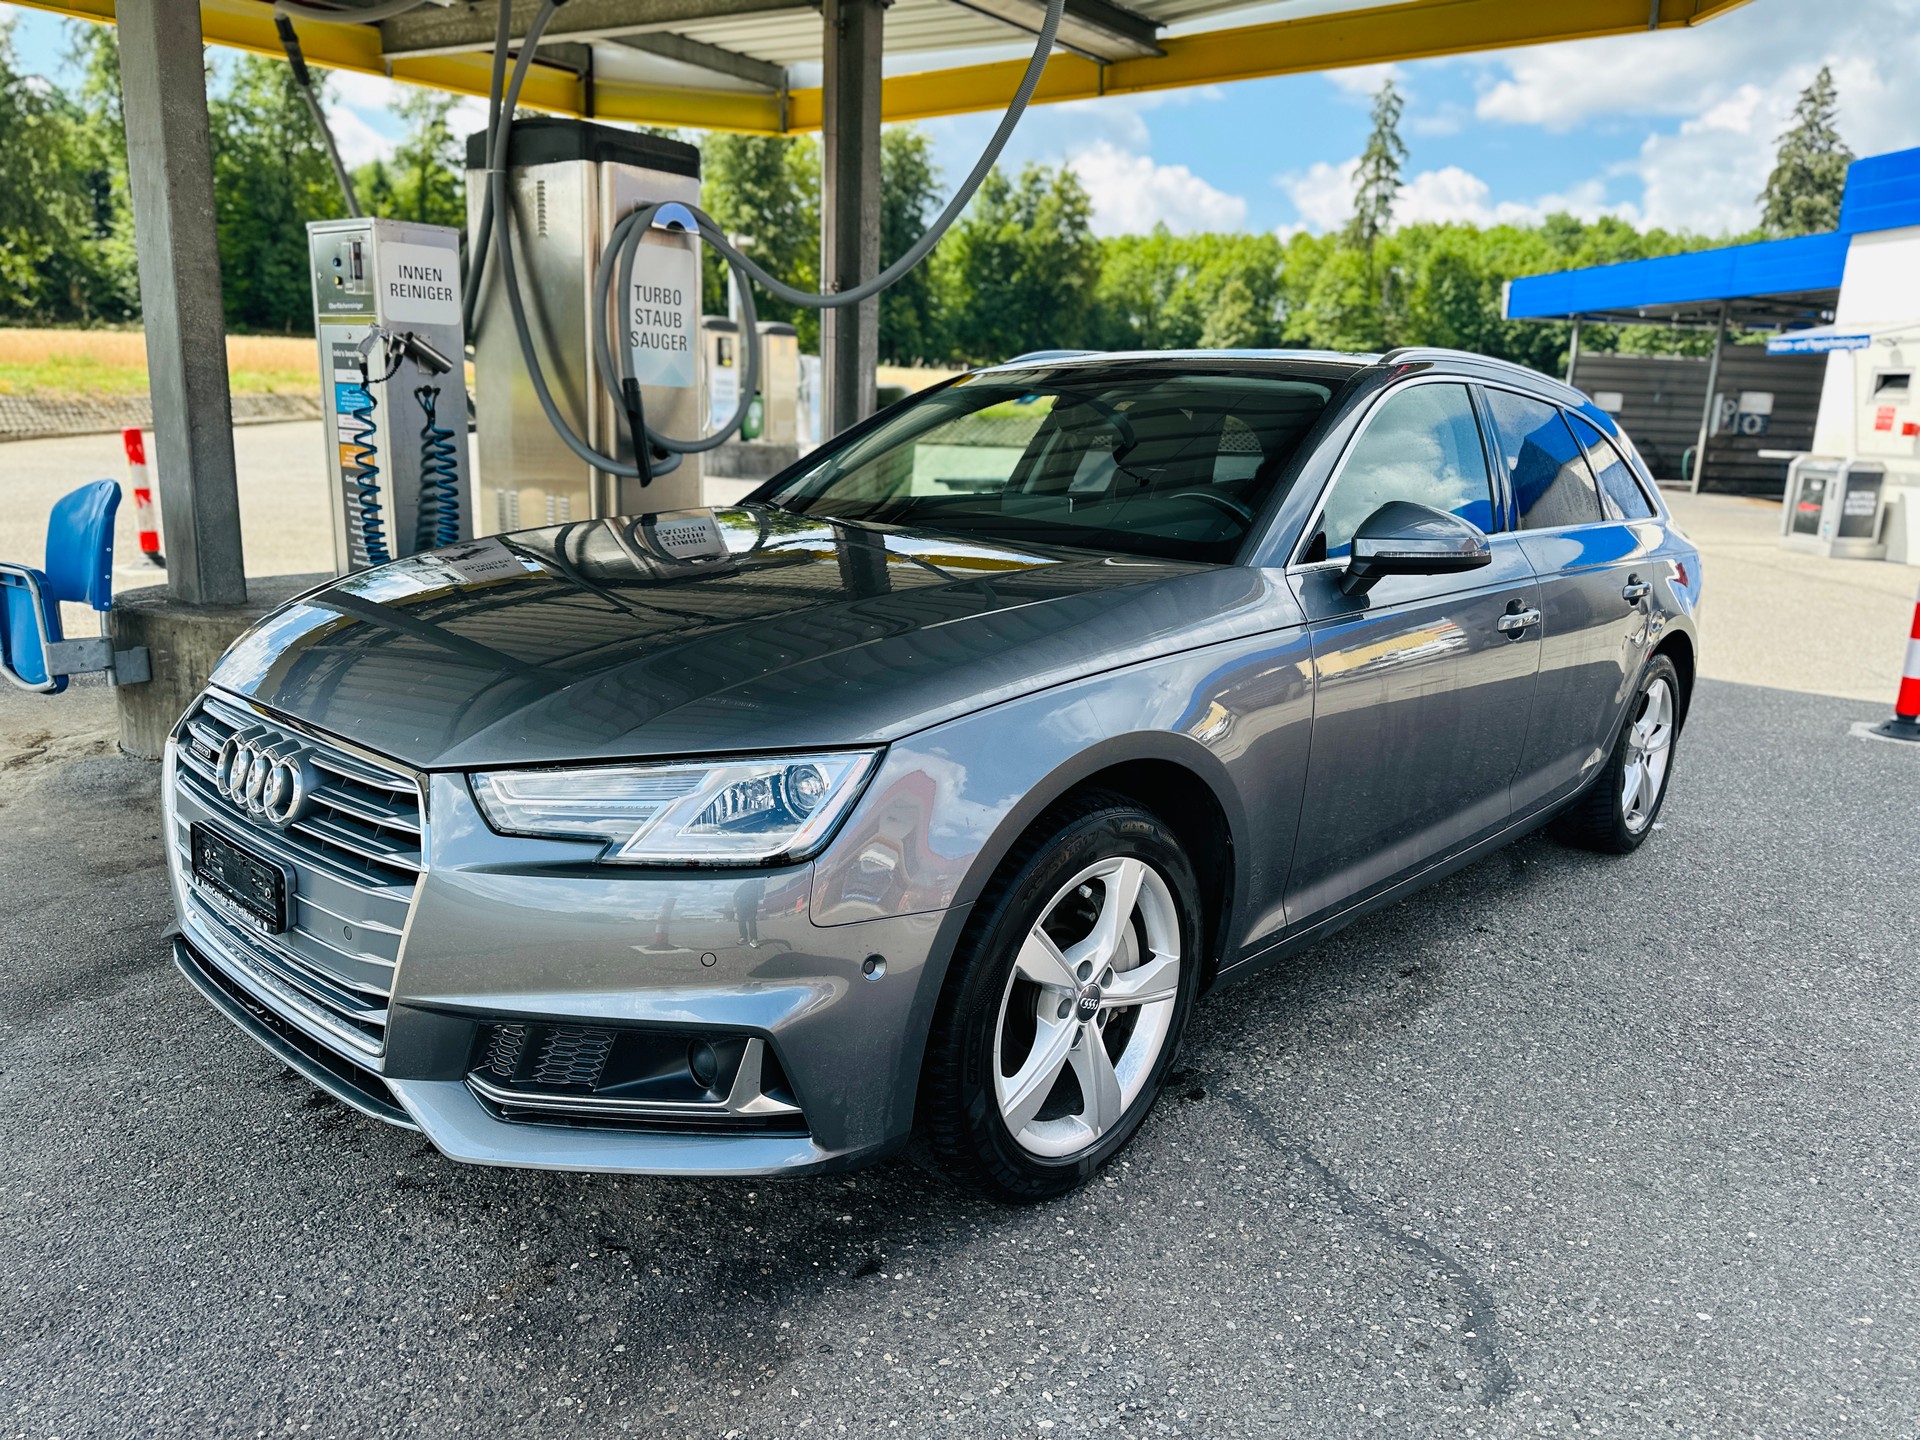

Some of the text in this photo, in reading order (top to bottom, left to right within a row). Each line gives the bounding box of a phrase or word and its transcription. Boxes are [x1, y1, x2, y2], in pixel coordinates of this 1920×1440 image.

[398, 264, 443, 283] INNEN
[390, 282, 454, 302] REINIGER
[633, 284, 682, 306] TURBO
[634, 307, 682, 329] STAUB
[630, 330, 688, 352] SAUGER
